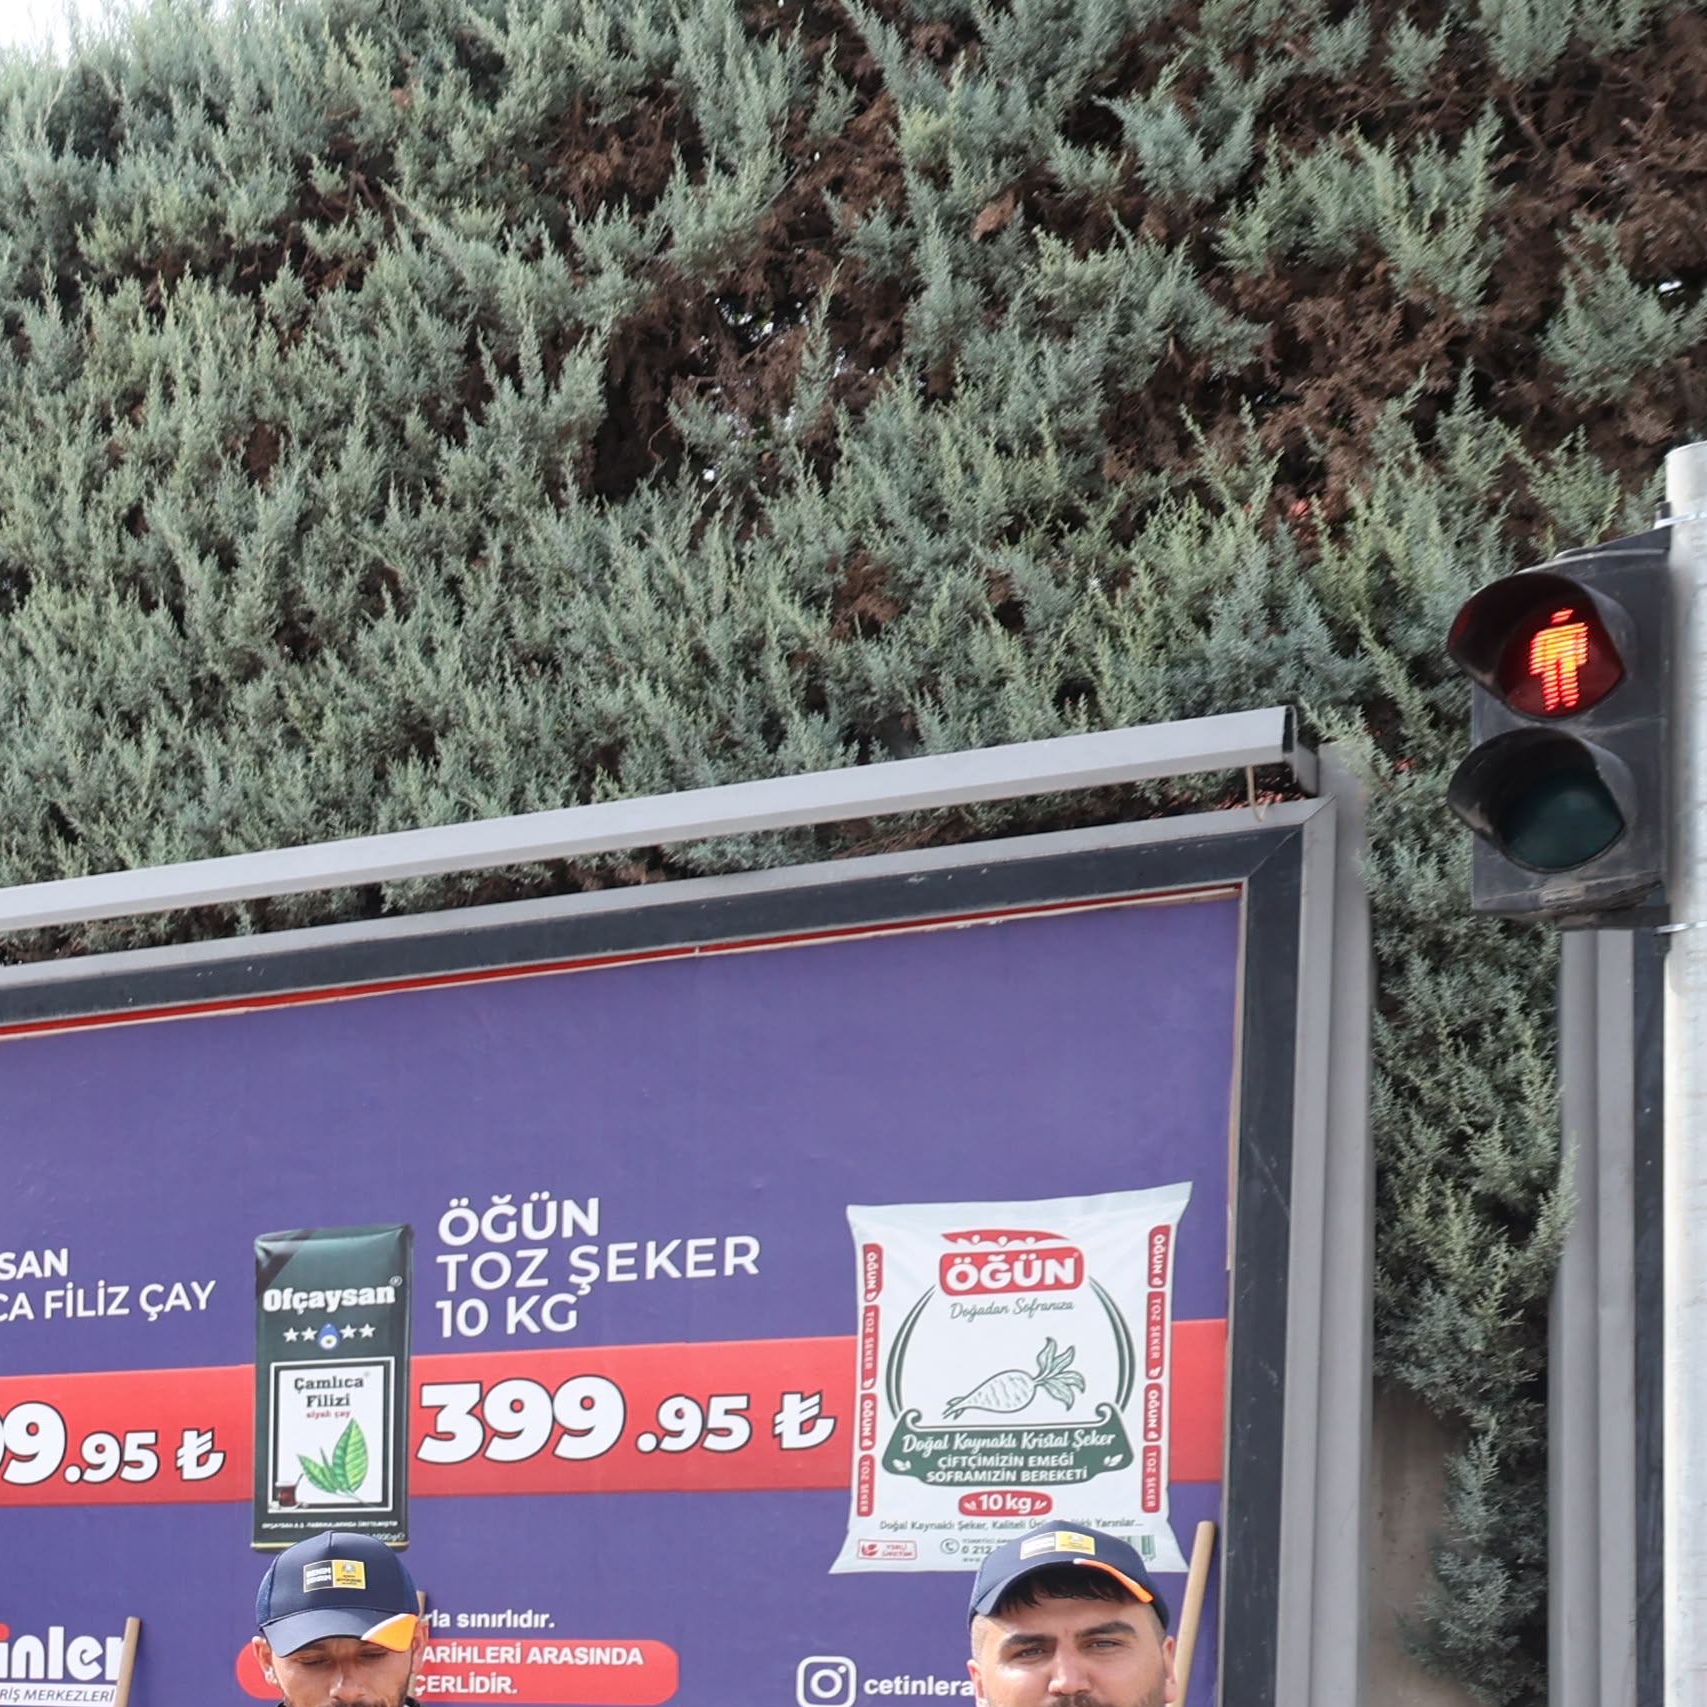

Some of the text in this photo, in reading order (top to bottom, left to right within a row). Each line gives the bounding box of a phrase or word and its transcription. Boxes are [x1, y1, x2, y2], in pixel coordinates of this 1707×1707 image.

[437, 1191, 601, 1246] ÖĞÜN
[435, 1235, 761, 1296] TOZ ŞEKER
[946, 1253, 1075, 1291] ÖĞÜN
[44, 1280, 130, 1319] FİLİZ
[139, 1279, 216, 1322] ÇAY
[263, 1284, 396, 1315] Ofçaysan
[435, 1293, 578, 1338] 10 KG
[951, 1302, 1008, 1323] Doğadan
[294, 1374, 364, 1394] Çamlıca
[306, 1392, 351, 1408] Filizi
[902, 1430, 1115, 1458] Doğal Kaynaklı Kristal Şeker
[938, 1452, 1075, 1469] ÇİFTÇİMİZİN EMEĞİ
[1021, 1467, 1088, 1482] BEREKETİ
[978, 1494, 1033, 1513] 10 kg
[457, 1609, 555, 1629] sınırlıdır.
[422, 1642, 644, 1665] ARİHLERİ ARASINDA
[24, 1687, 115, 1703] MERKEZLERİ
[415, 1673, 518, 1697] ÇERLİDİR.
[864, 1675, 975, 1697] cetinlera
